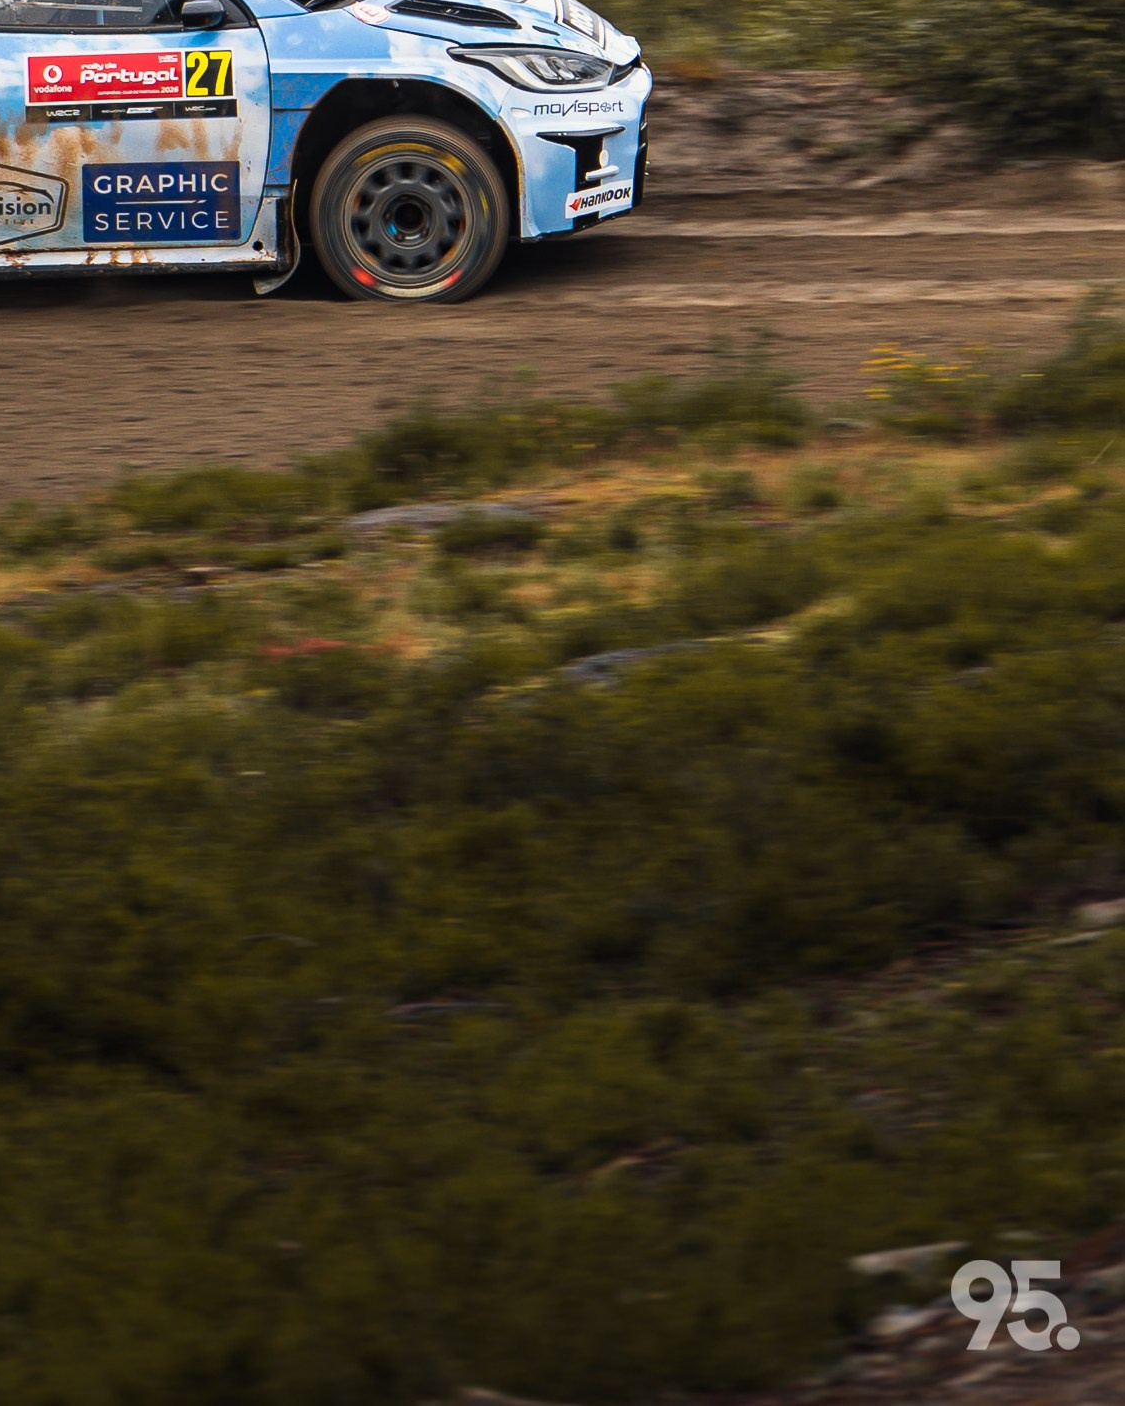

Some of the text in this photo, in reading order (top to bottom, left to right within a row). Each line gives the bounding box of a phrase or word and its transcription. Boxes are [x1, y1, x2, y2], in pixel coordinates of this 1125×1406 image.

[81, 61, 118, 71] rally de
[186, 51, 232, 96] 27
[80, 67, 179, 85] Portugal
[33, 84, 73, 94] vodafone
[534, 99, 624, 117] movisport
[93, 173, 229, 194] GRAPHIC
[94, 211, 230, 231] SERVICE
